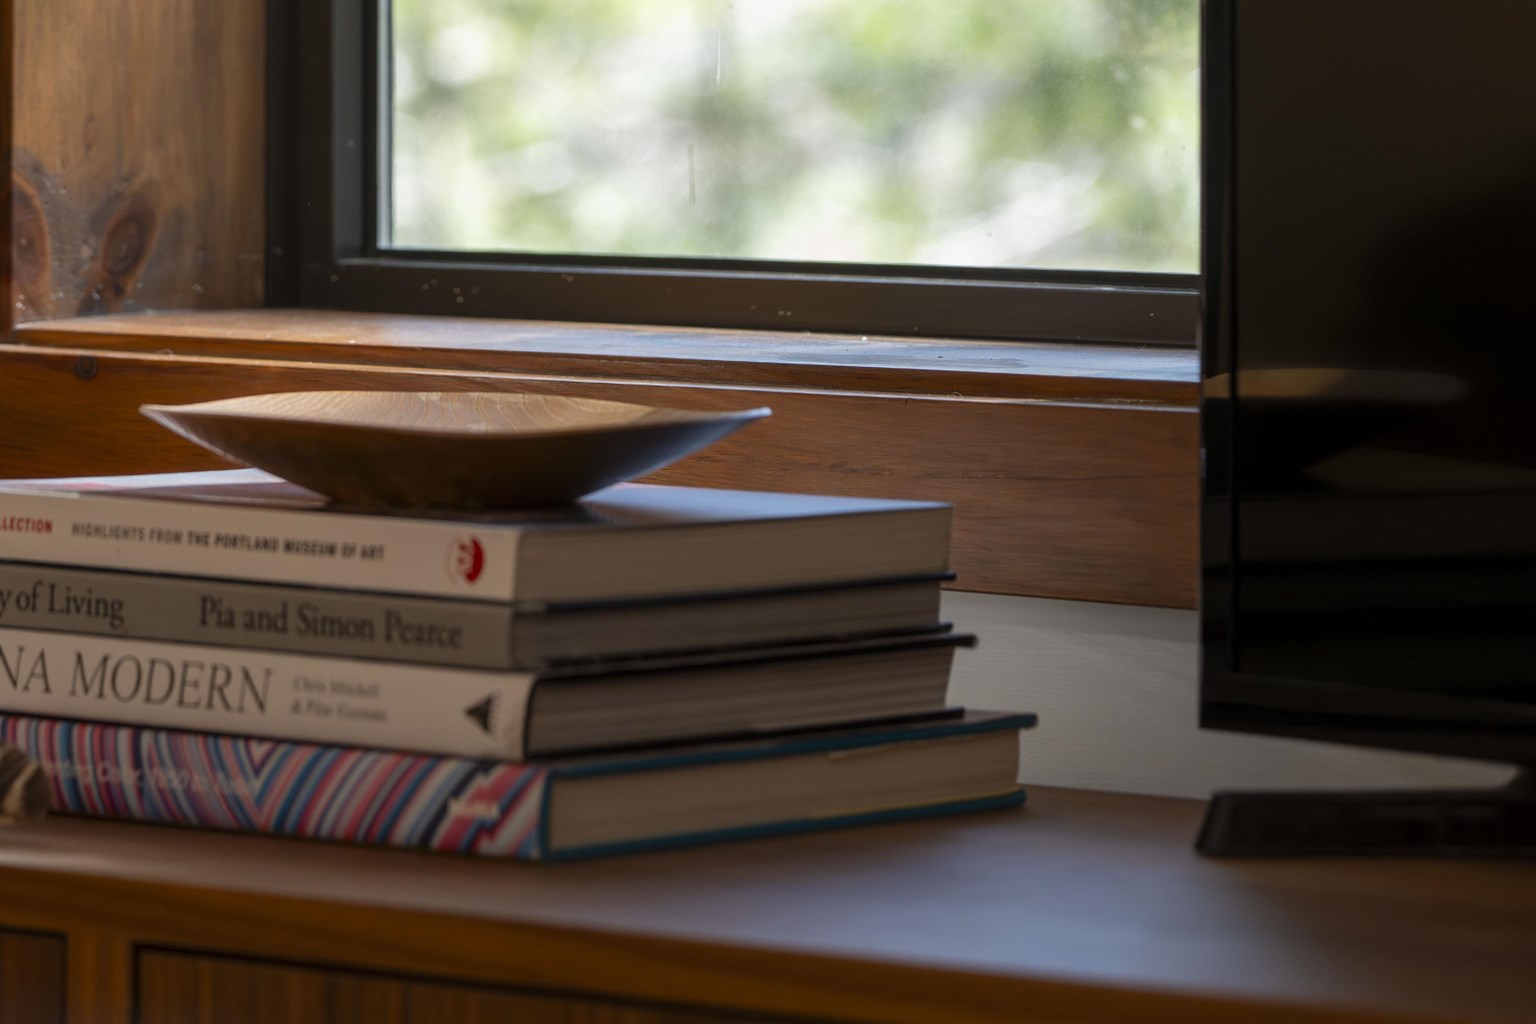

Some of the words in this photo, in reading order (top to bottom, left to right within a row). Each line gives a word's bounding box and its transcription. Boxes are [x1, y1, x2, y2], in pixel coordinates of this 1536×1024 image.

[72, 522, 145, 542] HIGHLIGHTS
[149, 528, 182, 545] FROM
[187, 530, 210, 548] THE
[213, 531, 279, 554] PORTLAND
[283, 536, 337, 557] MUSEUM
[341, 541, 357, 560] OF
[361, 544, 385, 563] ART
[15, 580, 44, 612] of
[48, 582, 125, 627] Living
[200, 595, 236, 630] Pia
[242, 599, 289, 636] and
[296, 602, 375, 642] Simon
[384, 607, 464, 650] Pearce
[69, 650, 272, 716] MODERN
